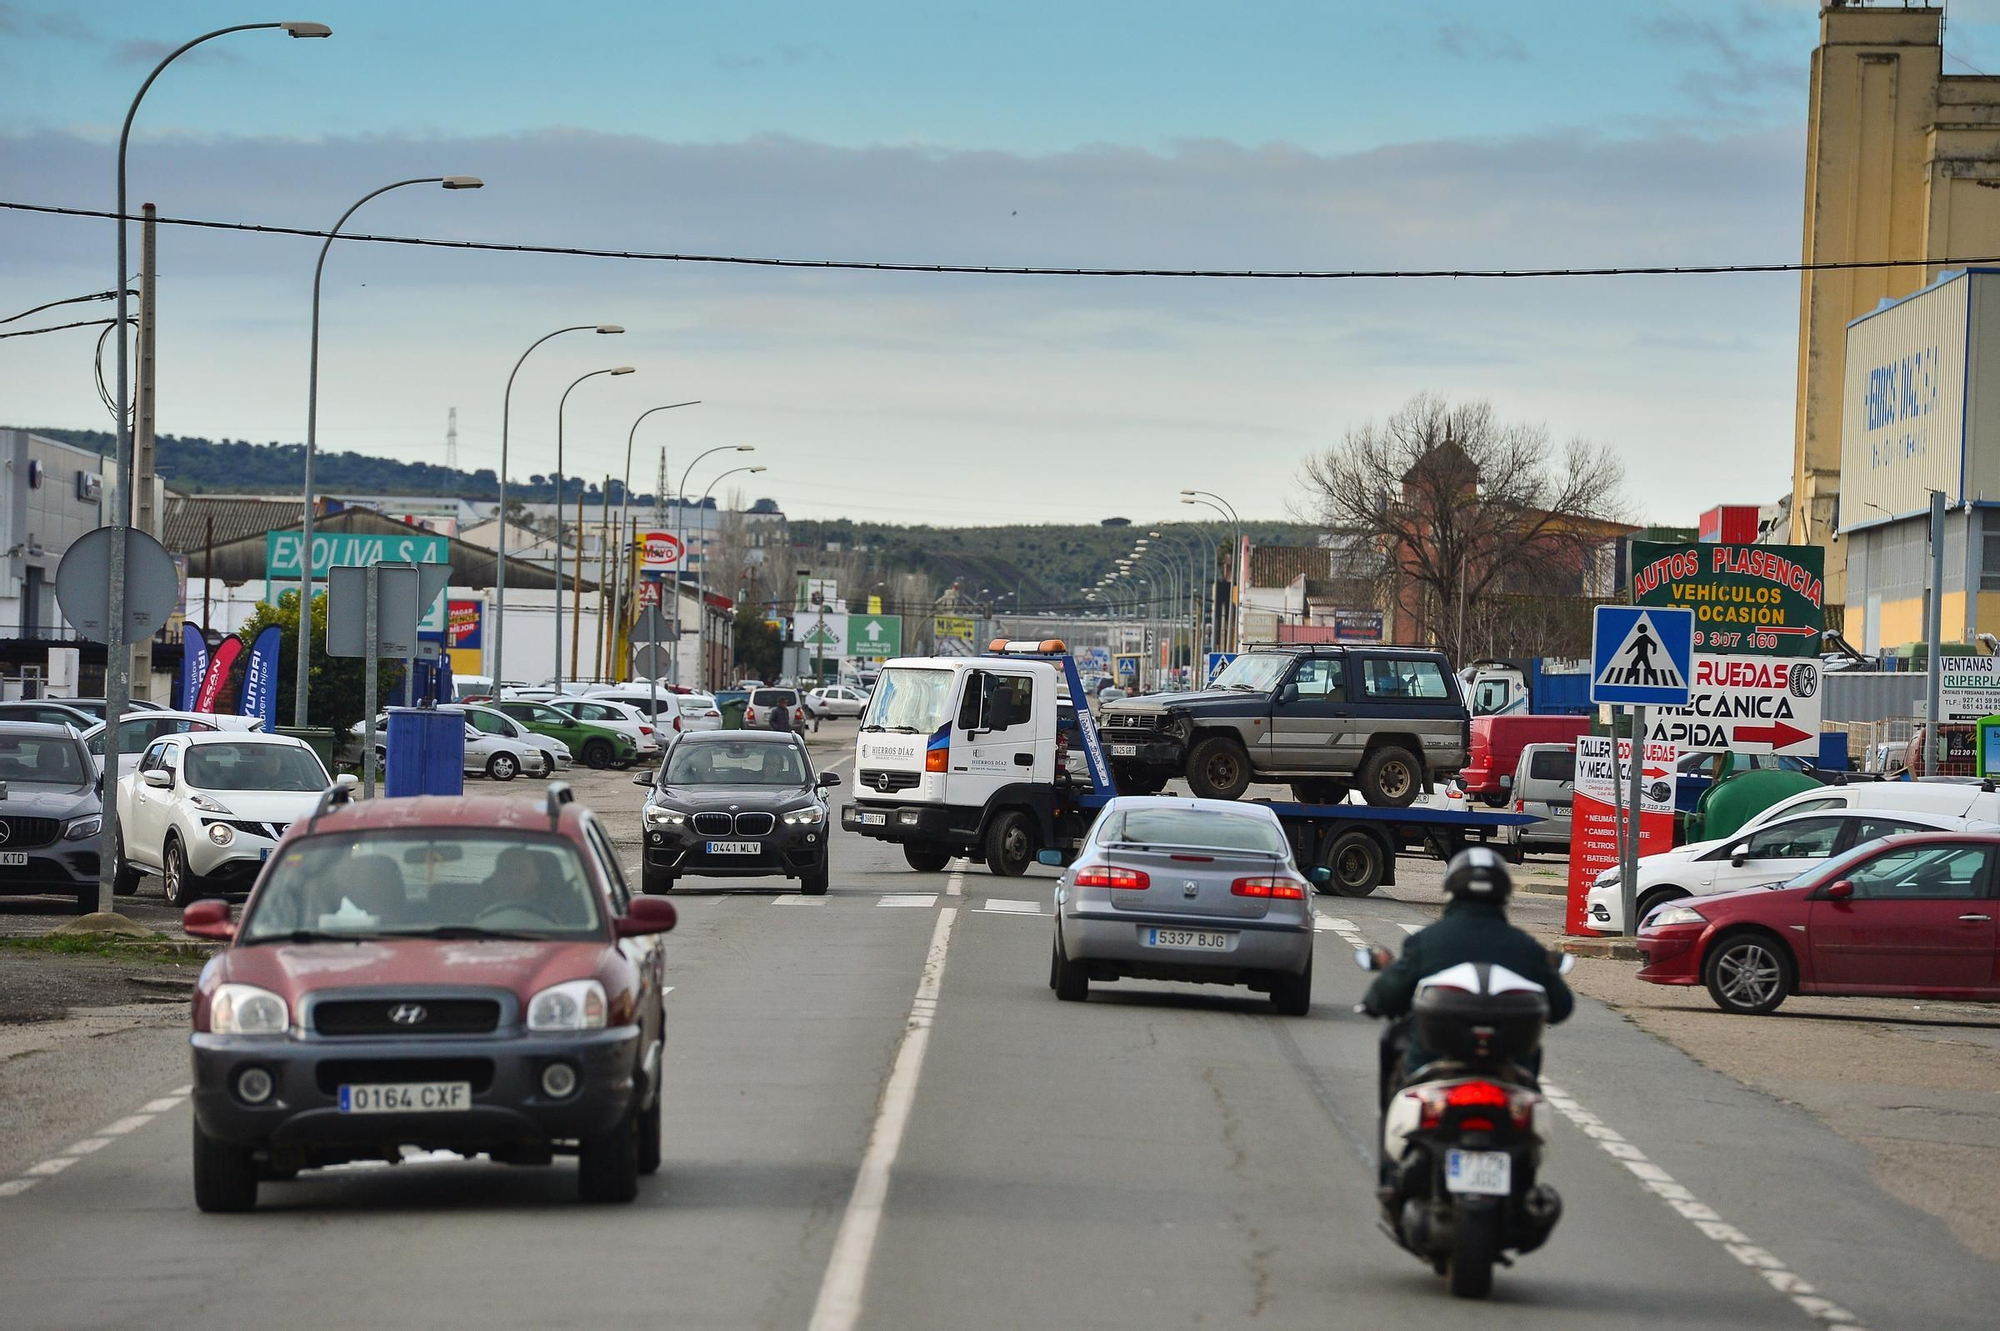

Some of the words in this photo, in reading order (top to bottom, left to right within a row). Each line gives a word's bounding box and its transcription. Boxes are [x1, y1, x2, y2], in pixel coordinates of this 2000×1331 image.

[272, 536, 383, 570] EXOLIVA
[643, 545, 673, 558] MAYO
[1634, 549, 1699, 604] AUTOS
[1713, 547, 1822, 611] PLASENCIA
[1672, 582, 1782, 604] VEHÍCULOS
[450, 608, 473, 616] PAGAR
[1698, 605, 1785, 625] OCASIÓN
[449, 623, 474, 633] MEJOR
[1710, 631, 1741, 648] 307
[1747, 633, 1778, 649] 160
[1941, 657, 1993, 672] VENTANAS
[1696, 660, 1789, 689] RUEDAS
[202, 659, 221, 714] ISSAN
[245, 650, 261, 718] YUNDAI
[1645, 719, 1729, 748] ÁPIDA
[872, 746, 896, 755] HIERROS
[898, 746, 914, 755] DÍAZ
[1580, 740, 1610, 758] TALLER
[1579, 761, 1585, 777] Y
[1588, 828, 1615, 836] CAMBIO
[713, 844, 736, 852] 0441
[741, 844, 758, 852] MLV
[1588, 841, 1615, 849] FILTROS
[3, 853, 25, 864] KTD
[1587, 854, 1620, 863] BATERÍAS
[1159, 932, 1193, 945] 5337
[1198, 934, 1224, 947] BJG
[355, 1088, 411, 1109] 0164
[421, 1085, 462, 1106] CXF
